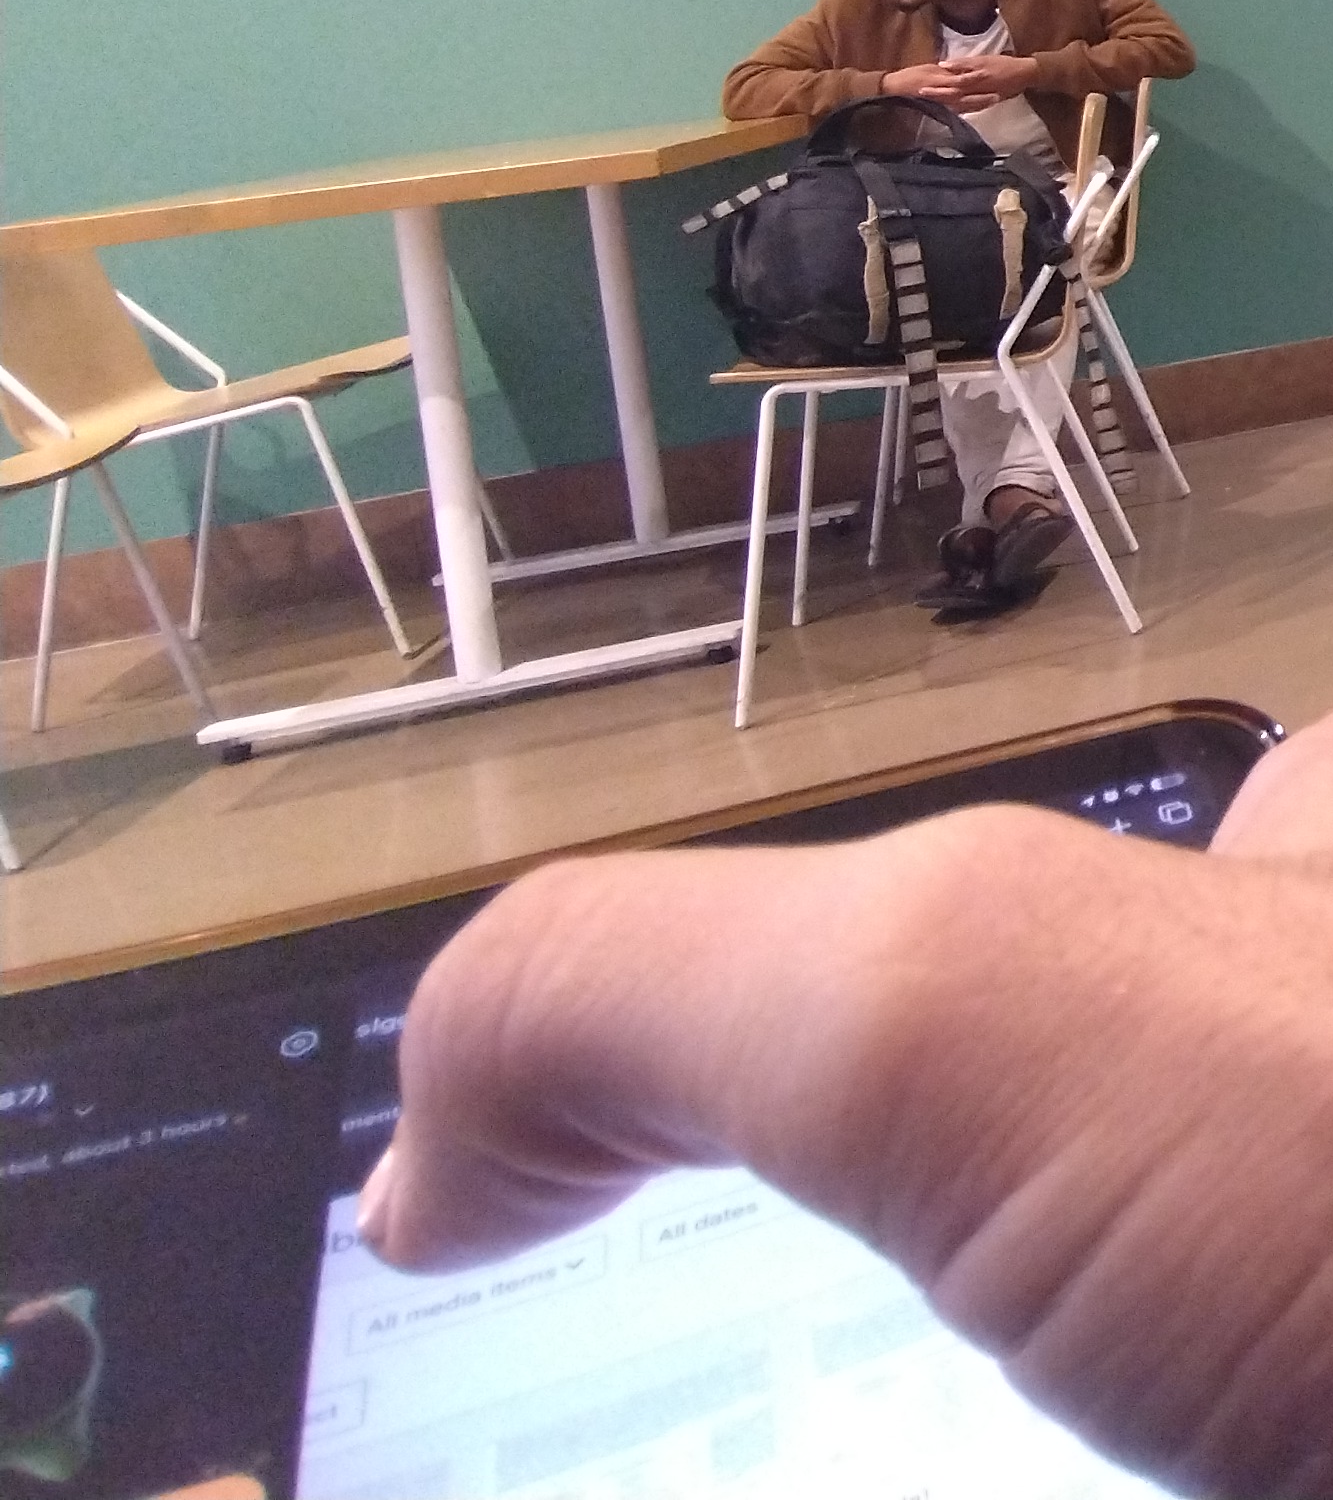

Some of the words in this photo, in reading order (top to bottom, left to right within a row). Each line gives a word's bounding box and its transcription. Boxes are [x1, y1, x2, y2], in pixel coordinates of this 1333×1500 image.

[657, 1220, 688, 1244] All
[694, 1200, 761, 1233] dates
[366, 1313, 399, 1337] All
[405, 1288, 483, 1325] media
[489, 1265, 559, 1298] items
